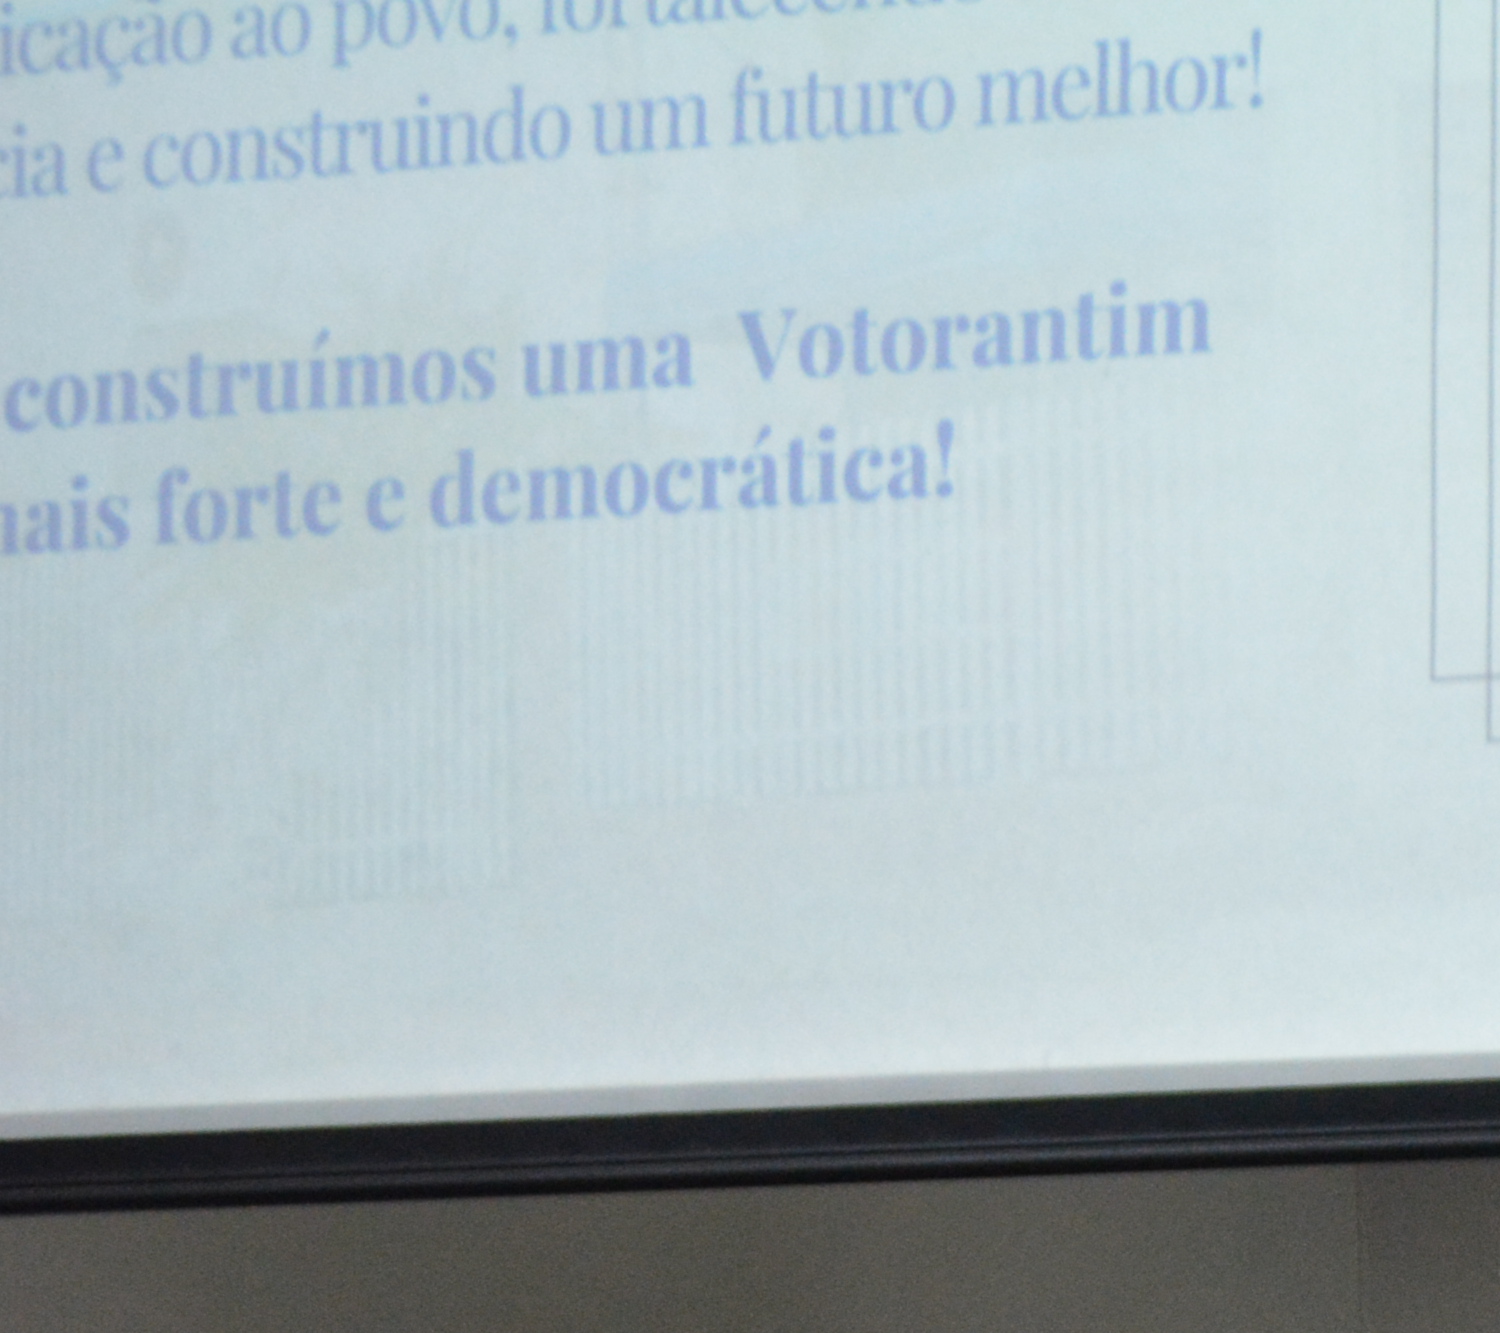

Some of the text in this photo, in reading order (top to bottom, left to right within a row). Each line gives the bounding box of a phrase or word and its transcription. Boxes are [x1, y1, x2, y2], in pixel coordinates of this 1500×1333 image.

[230, 0, 312, 60] ao
[86, 137, 125, 195] e
[143, 85, 572, 190] construindo
[592, 92, 710, 157] um
[729, 64, 956, 147] futuro
[973, 26, 1265, 127] melhor!
[4, 279, 1214, 434] construímos uma Votorantim
[156, 466, 343, 546] forte
[365, 474, 406, 533] e
[428, 418, 956, 531] democrática!
